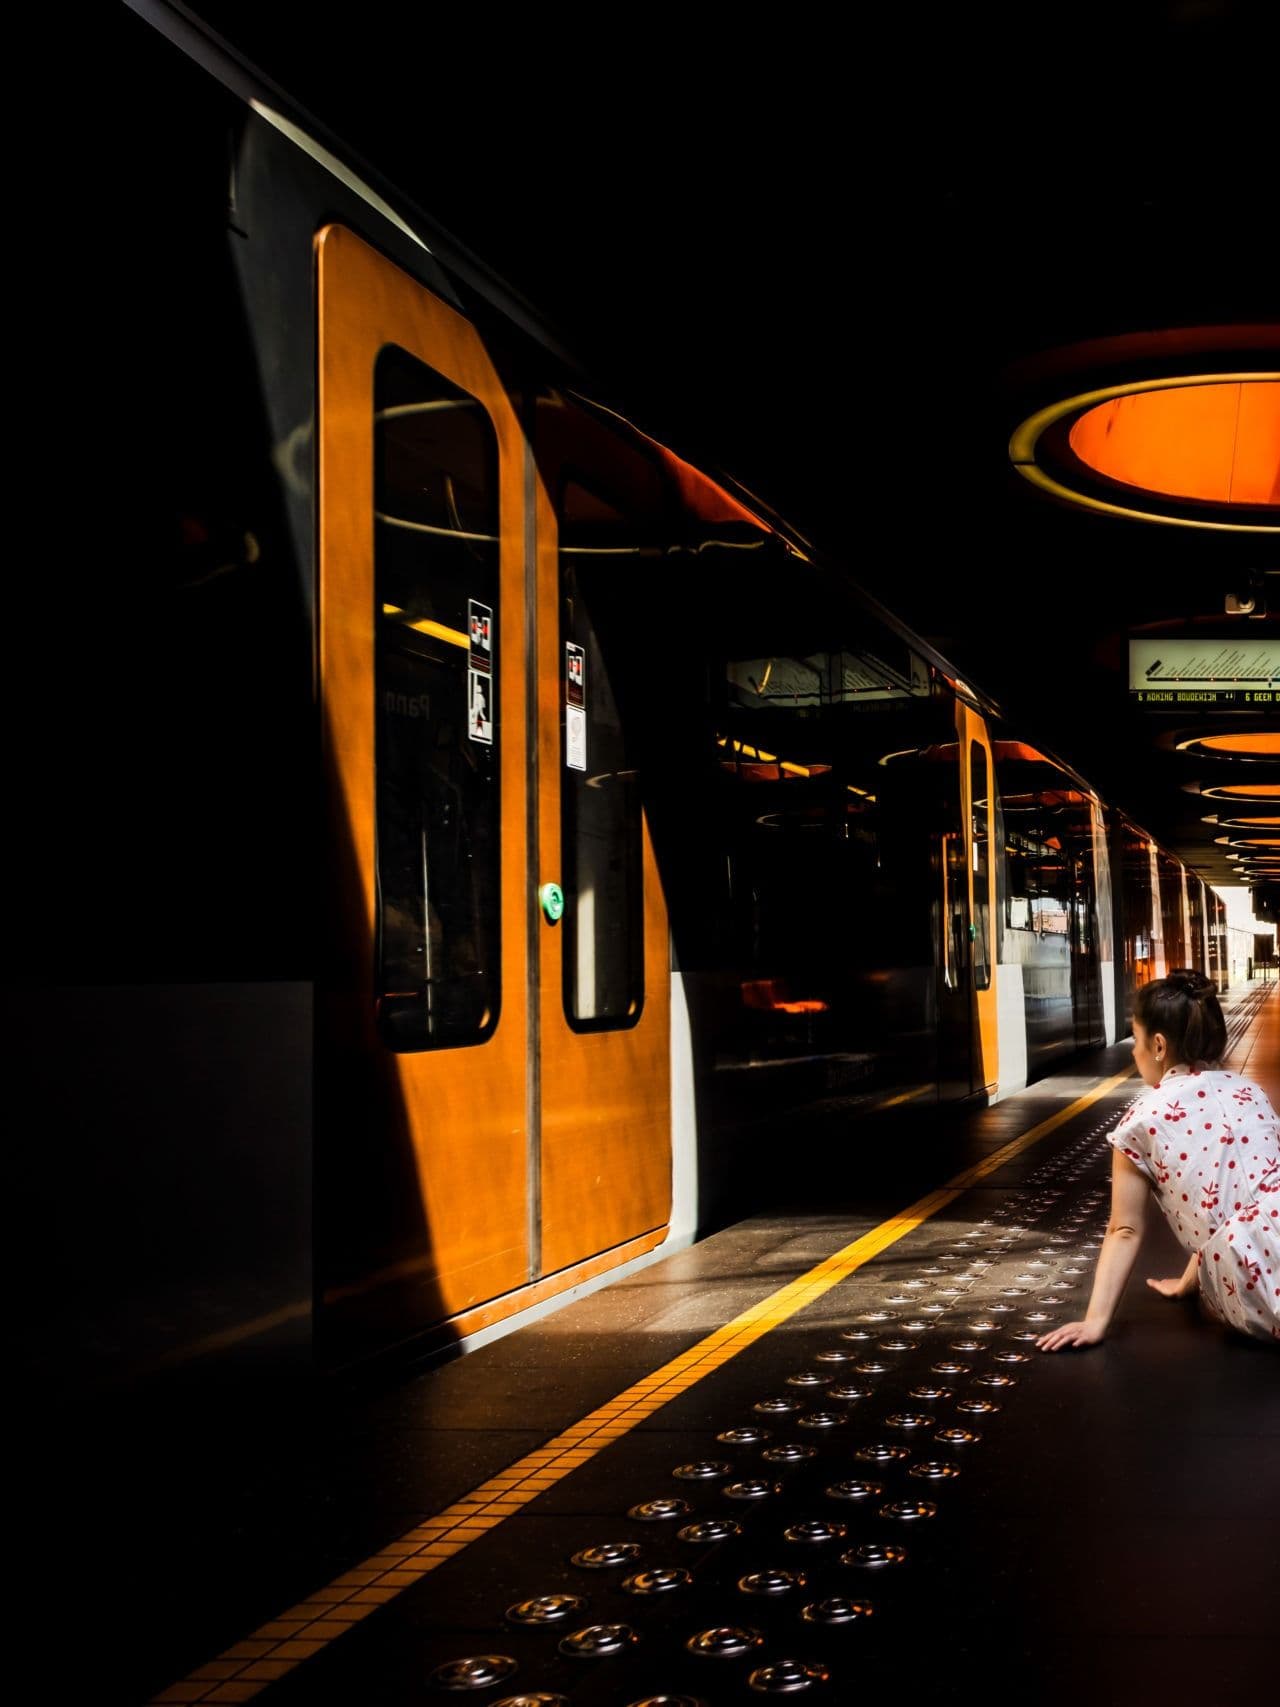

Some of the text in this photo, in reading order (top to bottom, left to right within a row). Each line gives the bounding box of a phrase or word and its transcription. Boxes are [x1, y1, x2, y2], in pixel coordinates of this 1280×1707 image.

[1138, 692, 1143, 702] 6
[1245, 692, 1251, 702] 6
[1254, 692, 1272, 702] GEEN
